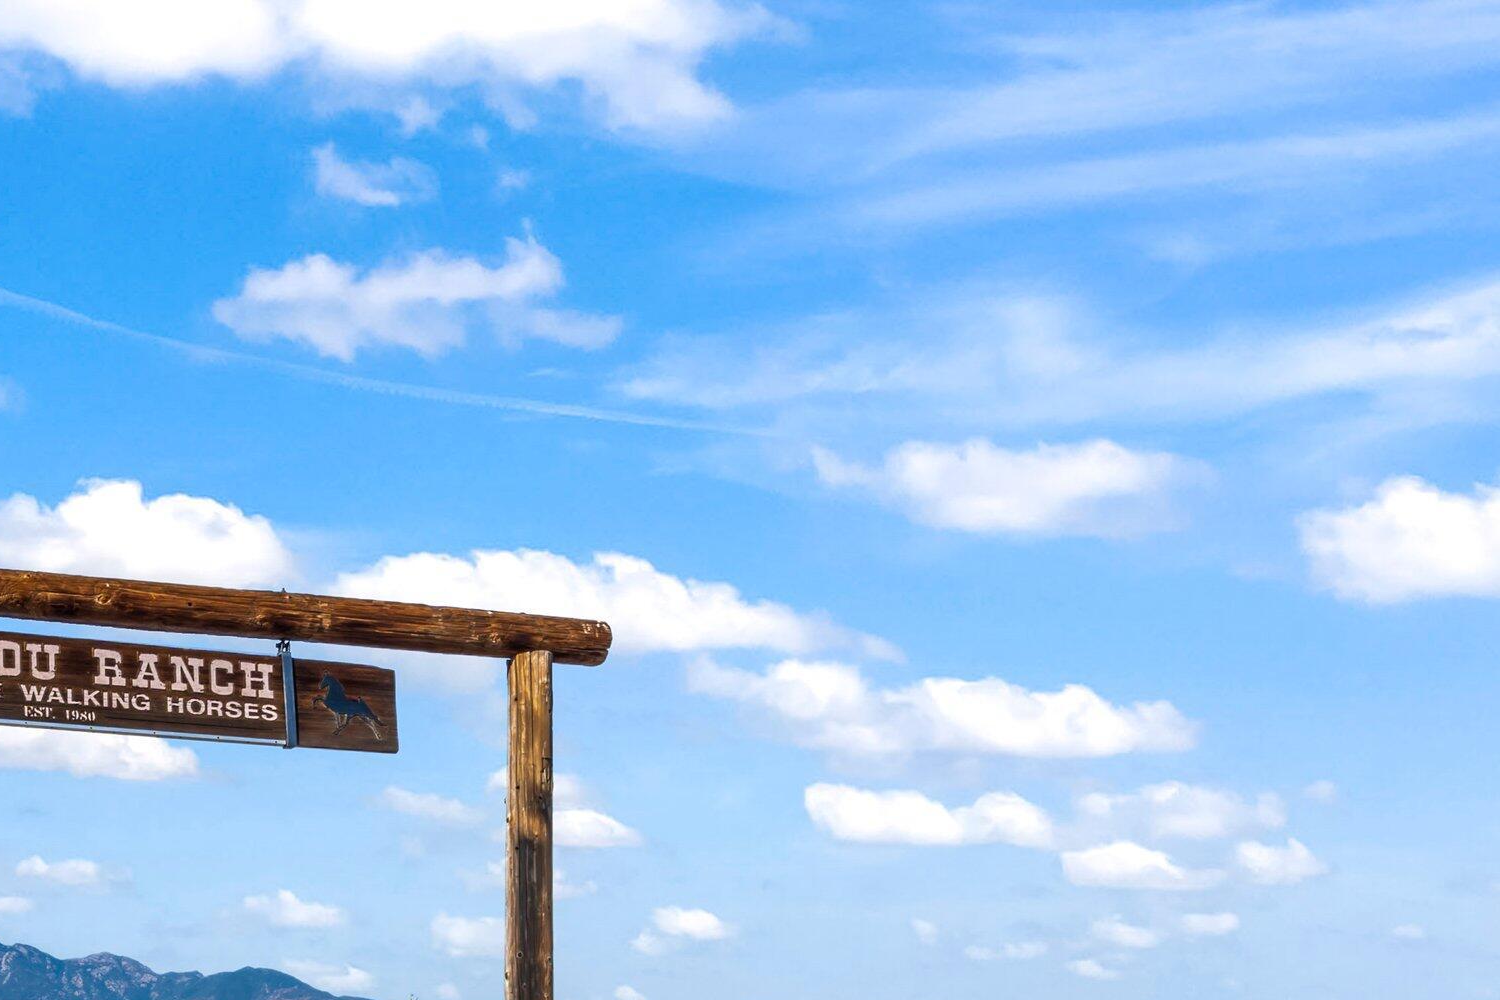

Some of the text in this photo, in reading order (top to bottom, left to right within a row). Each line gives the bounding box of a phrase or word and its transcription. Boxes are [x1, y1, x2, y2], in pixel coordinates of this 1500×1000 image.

[92, 648, 275, 700] RANCH
[20, 684, 150, 711] WALKING
[166, 696, 279, 722] HORSES
[23, 705, 96, 722] EST. 1980
